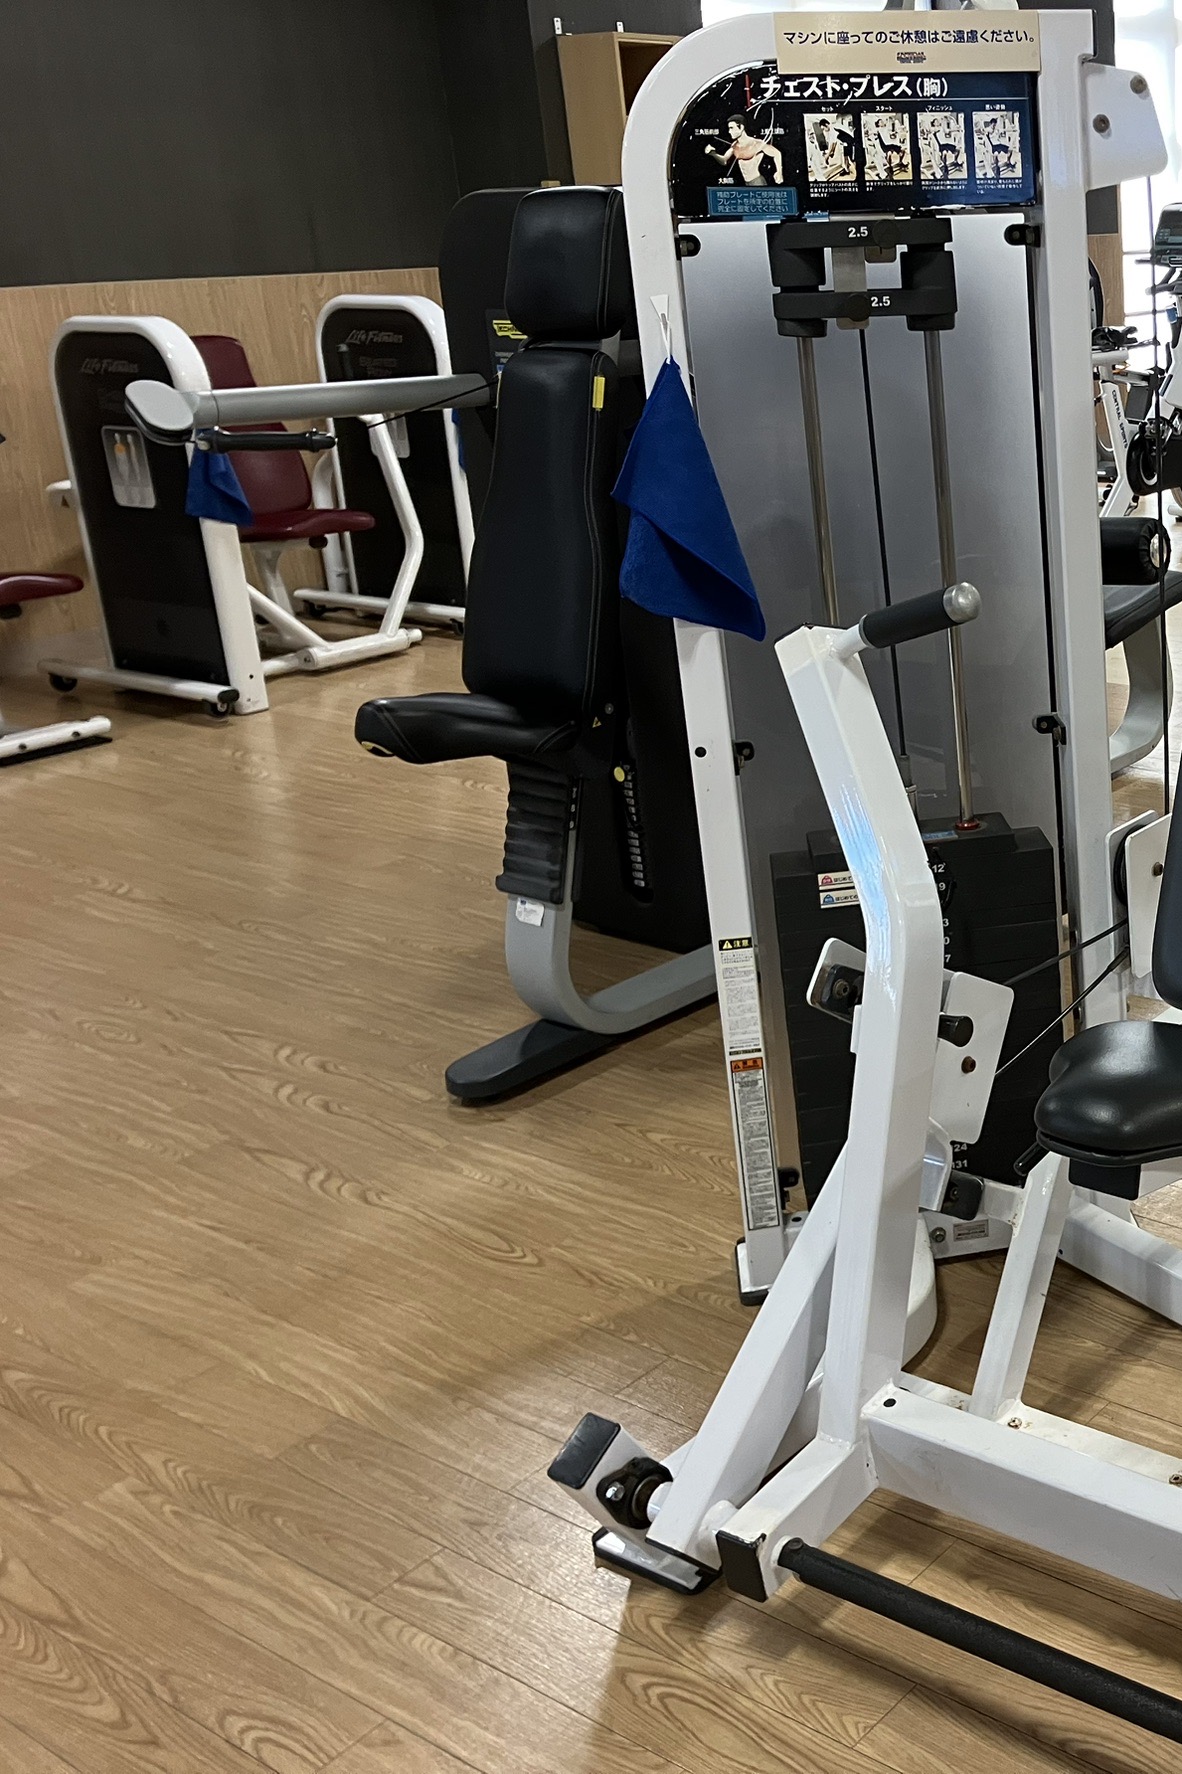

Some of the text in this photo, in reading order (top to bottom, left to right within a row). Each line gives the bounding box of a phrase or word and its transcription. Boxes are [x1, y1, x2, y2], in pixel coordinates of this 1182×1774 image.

[783, 30, 1035, 45] マシンに座ってのご休憩はご遠慮ください。
[848, 226, 869, 238] 2.5
[870, 296, 891, 307] 2.5
[932, 864, 944, 873] 12
[943, 918, 949, 927] 3
[944, 936, 950, 945] 0
[944, 954, 951, 963] 7
[953, 1143, 968, 1152] 24
